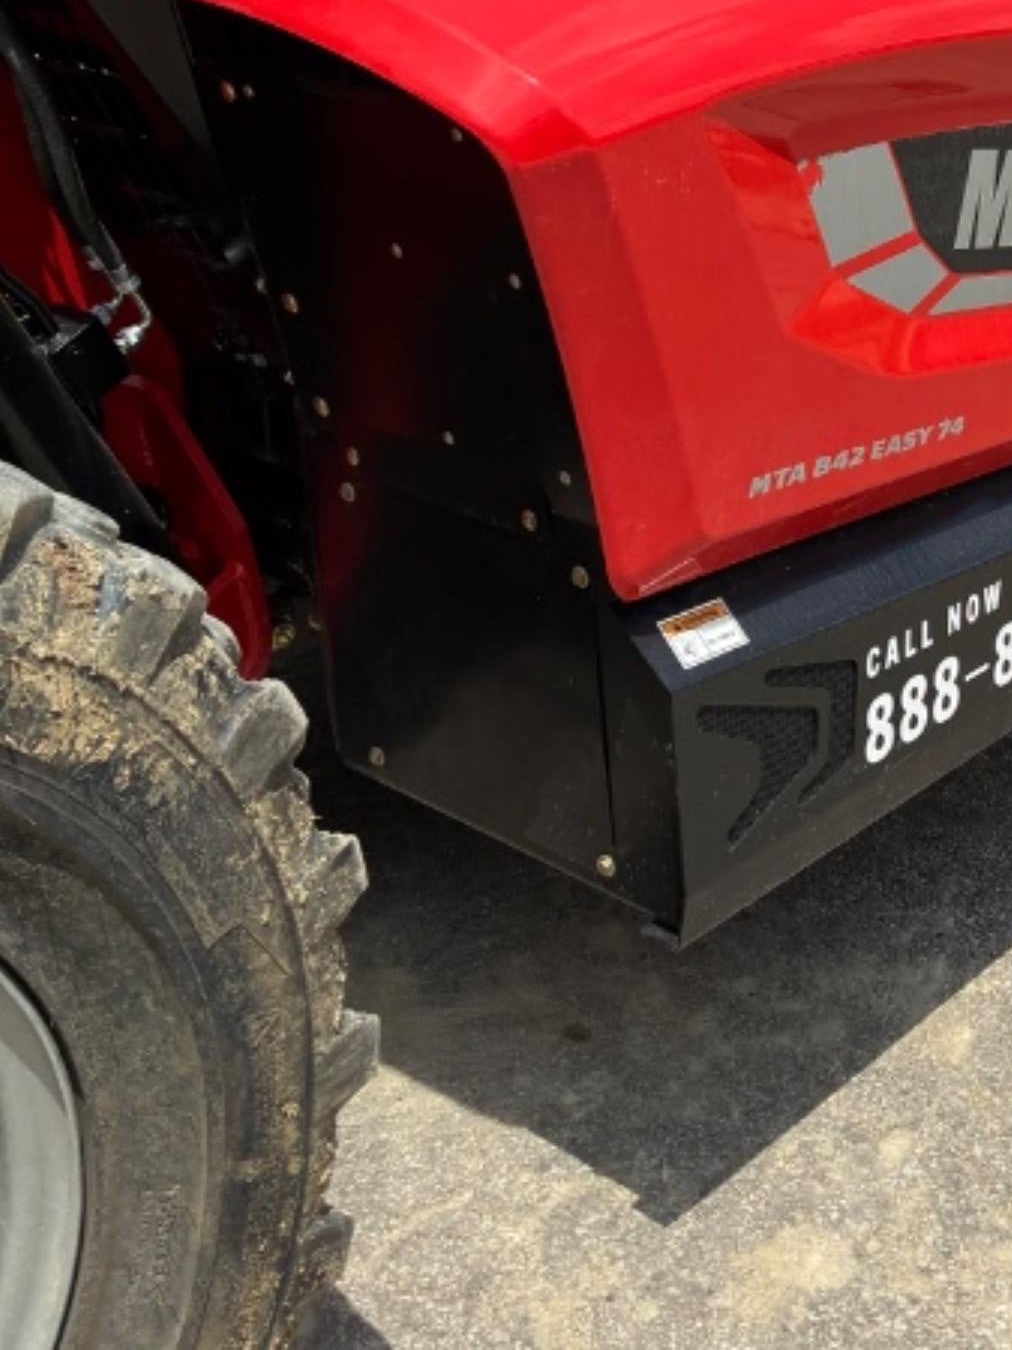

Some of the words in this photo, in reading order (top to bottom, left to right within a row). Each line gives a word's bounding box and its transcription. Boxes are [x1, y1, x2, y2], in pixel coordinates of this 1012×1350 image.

[748, 462, 806, 498] MTA
[869, 424, 934, 461] EASY
[866, 620, 934, 679] CALL
[947, 579, 1003, 637] NOW
